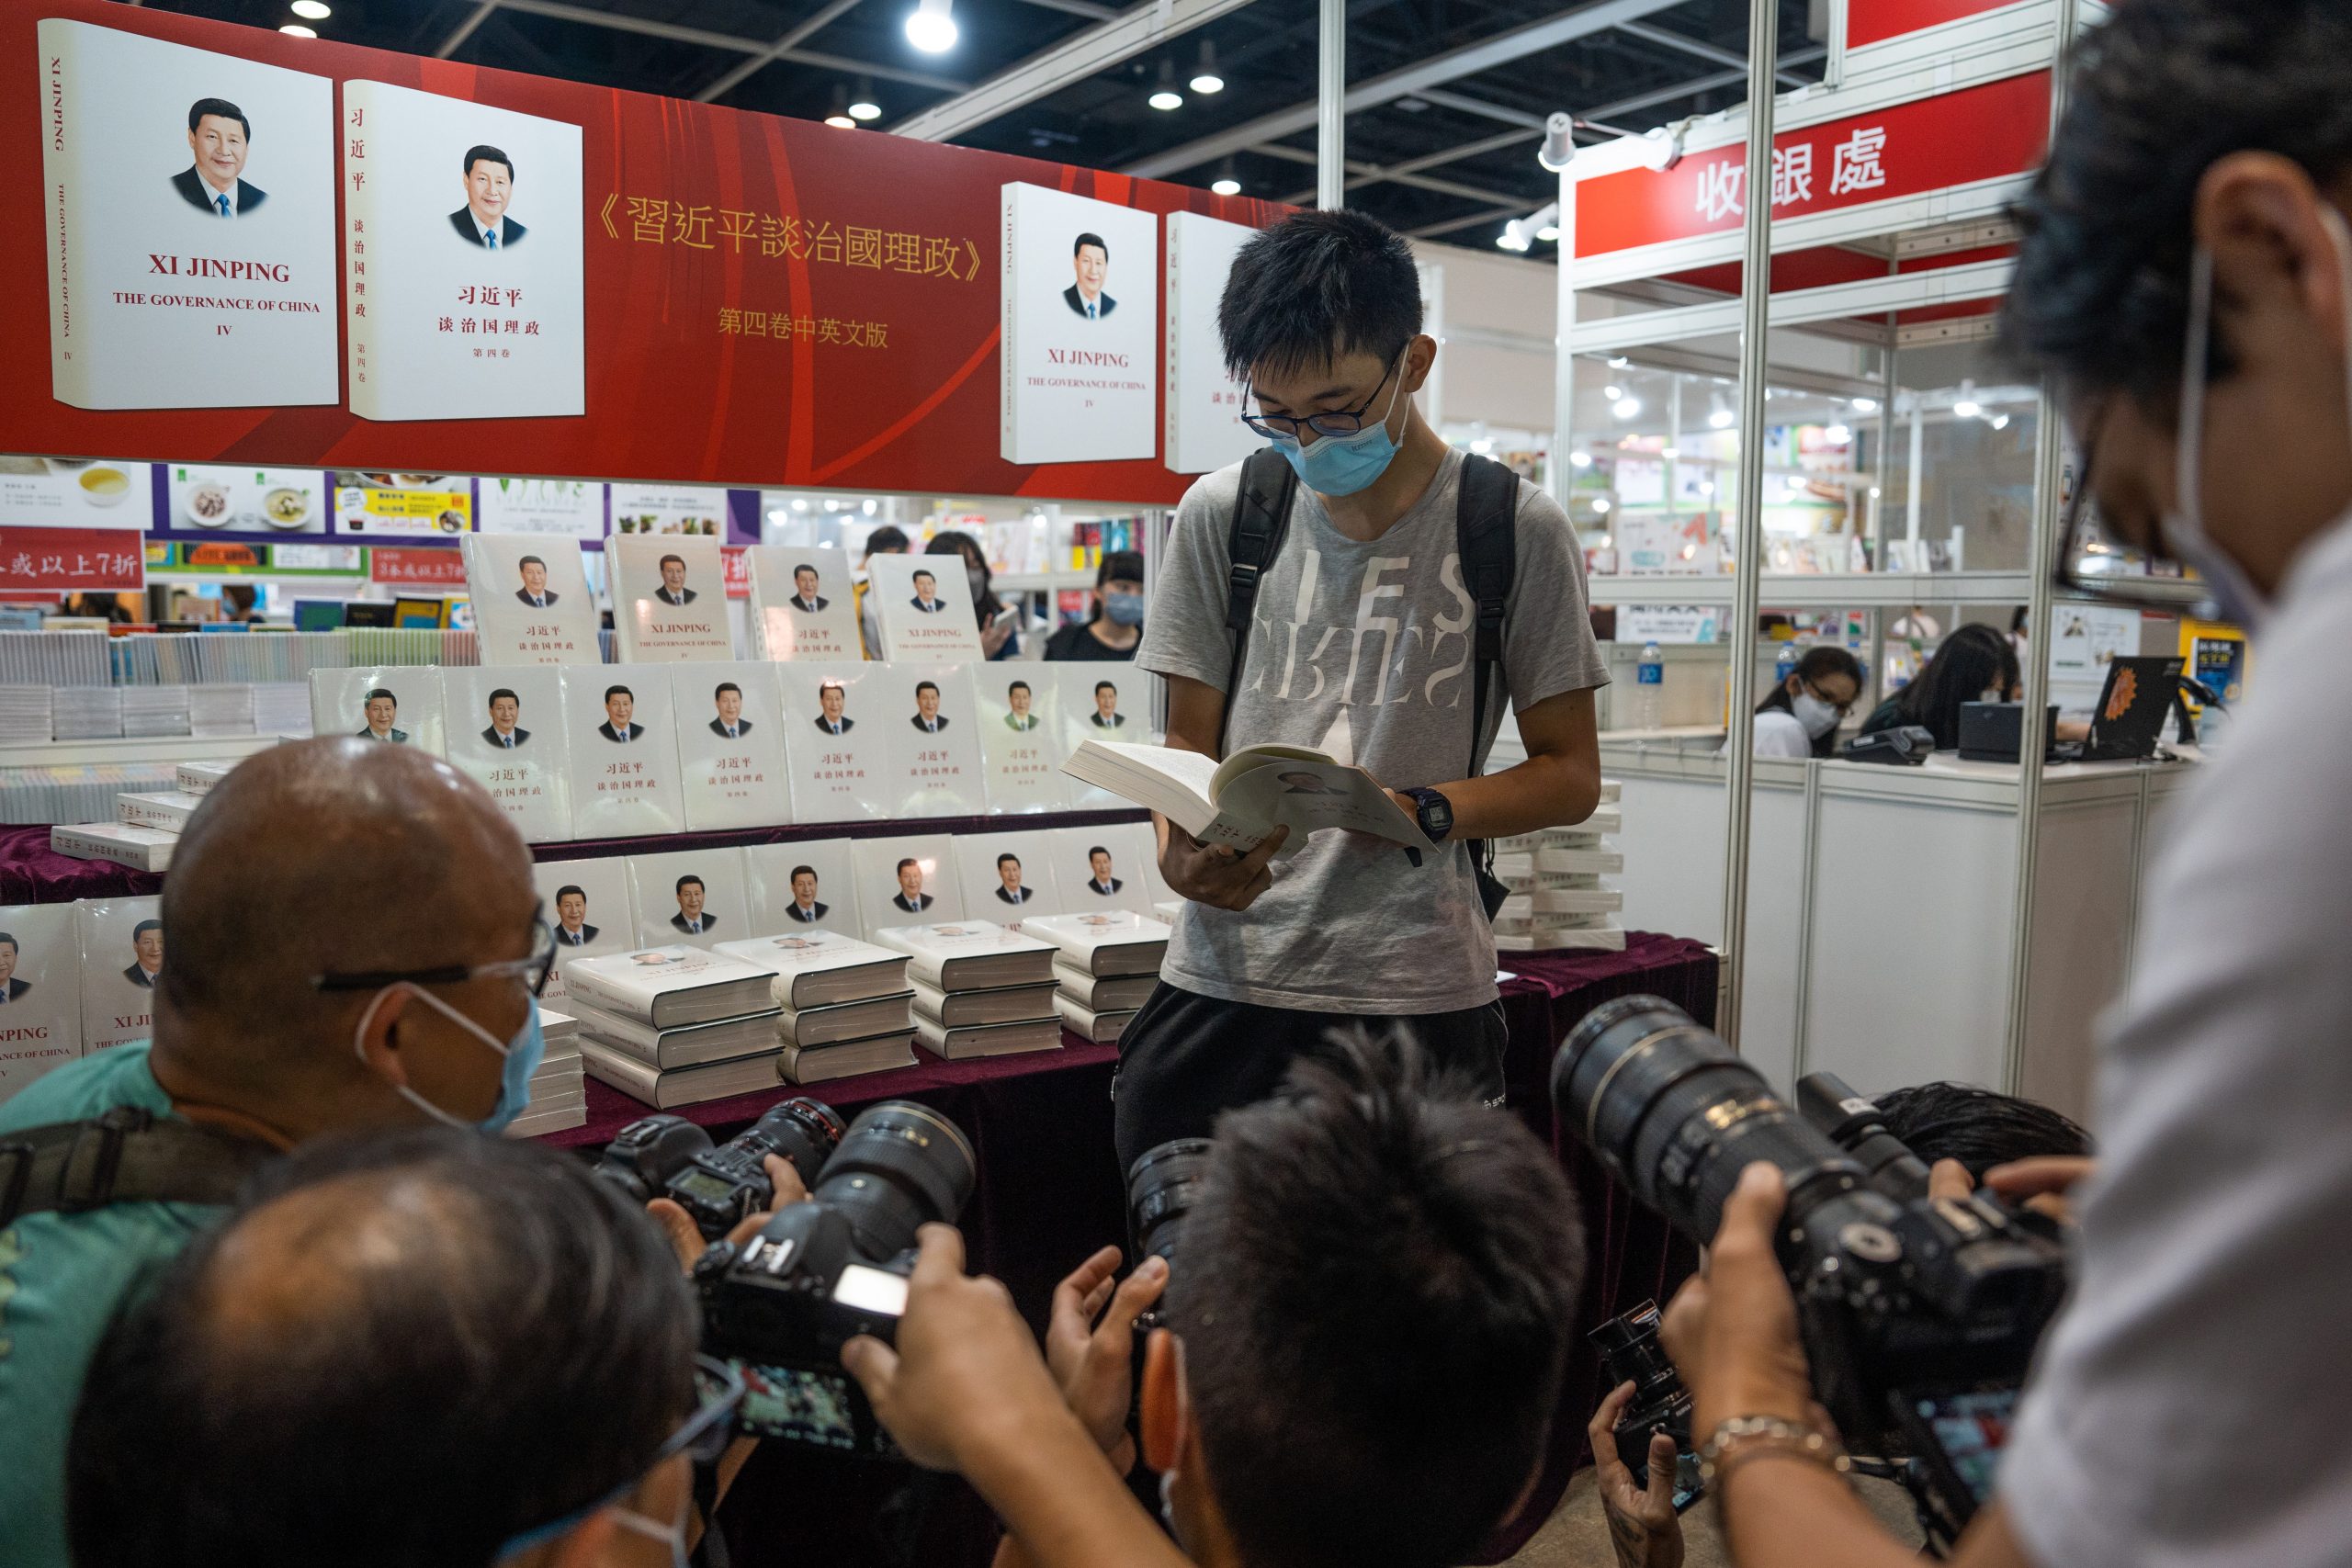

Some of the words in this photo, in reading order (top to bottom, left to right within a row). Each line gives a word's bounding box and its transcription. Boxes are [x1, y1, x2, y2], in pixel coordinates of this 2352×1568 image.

[51, 56, 61, 75] XI
[52, 80, 64, 152] JINPING
[350, 108, 366, 191] 习近平
[1695, 126, 1886, 222] 收銀處
[600, 192, 981, 282] 《習近平談治國理政》
[59, 207, 68, 284] GOVERNANCE
[148, 254, 179, 275] XI
[187, 257, 290, 283] JINPING
[354, 220, 366, 318] 谈治国理政
[62, 286, 69, 302] OF
[458, 285, 523, 308] 习近平
[112, 292, 147, 305] THE
[150, 294, 254, 310] GOVERNANCE
[257, 299, 277, 311] OF
[278, 301, 321, 313] CHINA
[216, 324, 232, 336] IV
[439, 316, 539, 336] 谈治国理政
[718, 307, 888, 348] 第四卷中英文版
[473, 348, 510, 358] 第四卷
[1048, 348, 1065, 364] XI
[1069, 350, 1129, 368] JINPING
[356, 343, 367, 383] 第四卷
[1027, 377, 1046, 387] THE
[1047, 378, 1108, 389] GOVERNANCE
[1109, 381, 1121, 389] OF
[1121, 381, 1147, 391] CHINA
[0, 551, 138, 578] 或以上7折
[526, 625, 561, 636] 习近平
[650, 624, 663, 634] XI
[666, 624, 711, 633] JINPING
[821, 753, 854, 764] 习近平
[918, 750, 949, 761] 习近平
[605, 761, 645, 774] 习近平
[717, 757, 752, 770] 习近平
[489, 768, 529, 781] 习近平
[708, 773, 764, 785] 谈治国理政
[597, 779, 657, 791] 谈治国理政
[547, 971, 559, 982] XI
[114, 1016, 132, 1029] XI
[95, 1040, 114, 1049] THE
[0, 1053, 23, 1061] NCE
[40, 1048, 71, 1057] CHINA
